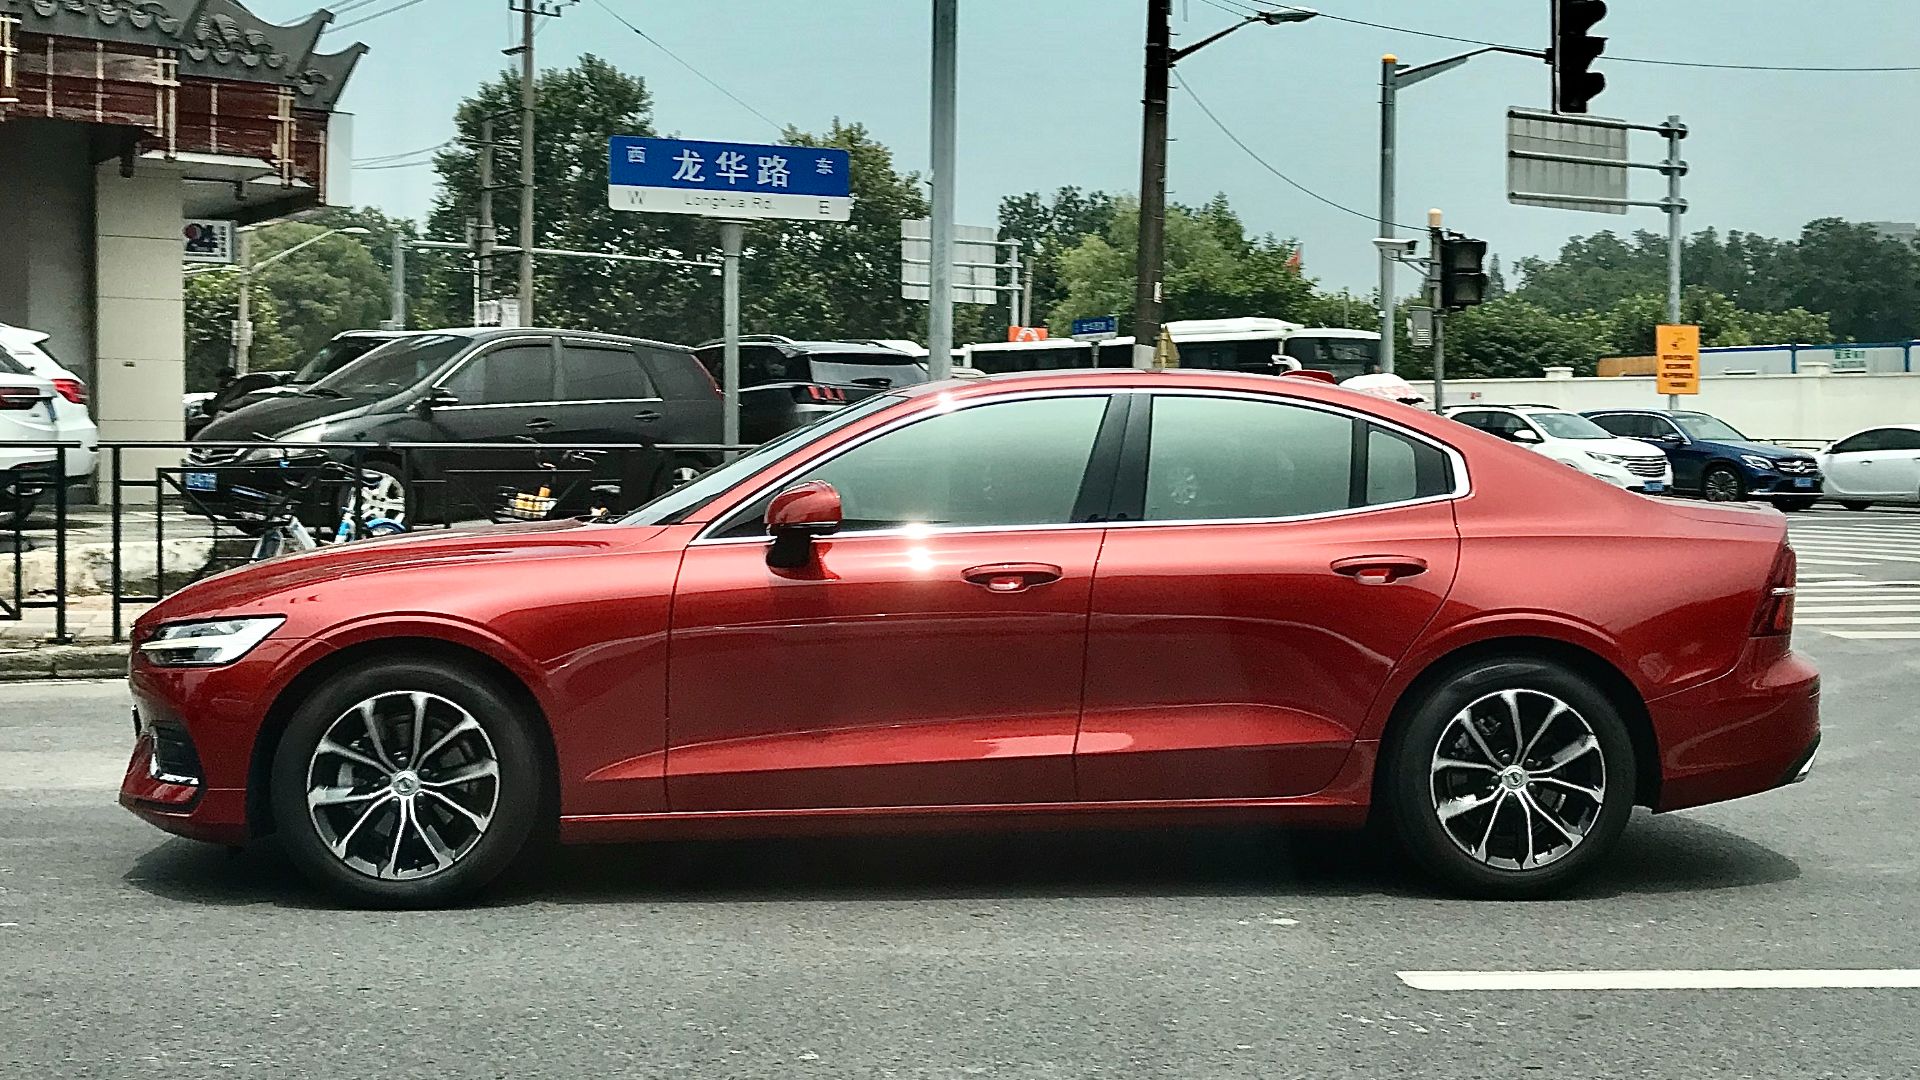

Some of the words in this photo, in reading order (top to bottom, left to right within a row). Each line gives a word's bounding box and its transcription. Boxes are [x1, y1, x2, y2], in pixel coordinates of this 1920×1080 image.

[626, 145, 647, 164] 西
[672, 148, 791, 188] 龙华路
[815, 157, 834, 175] 东
[627, 190, 647, 205] W
[819, 200, 831, 215] E
